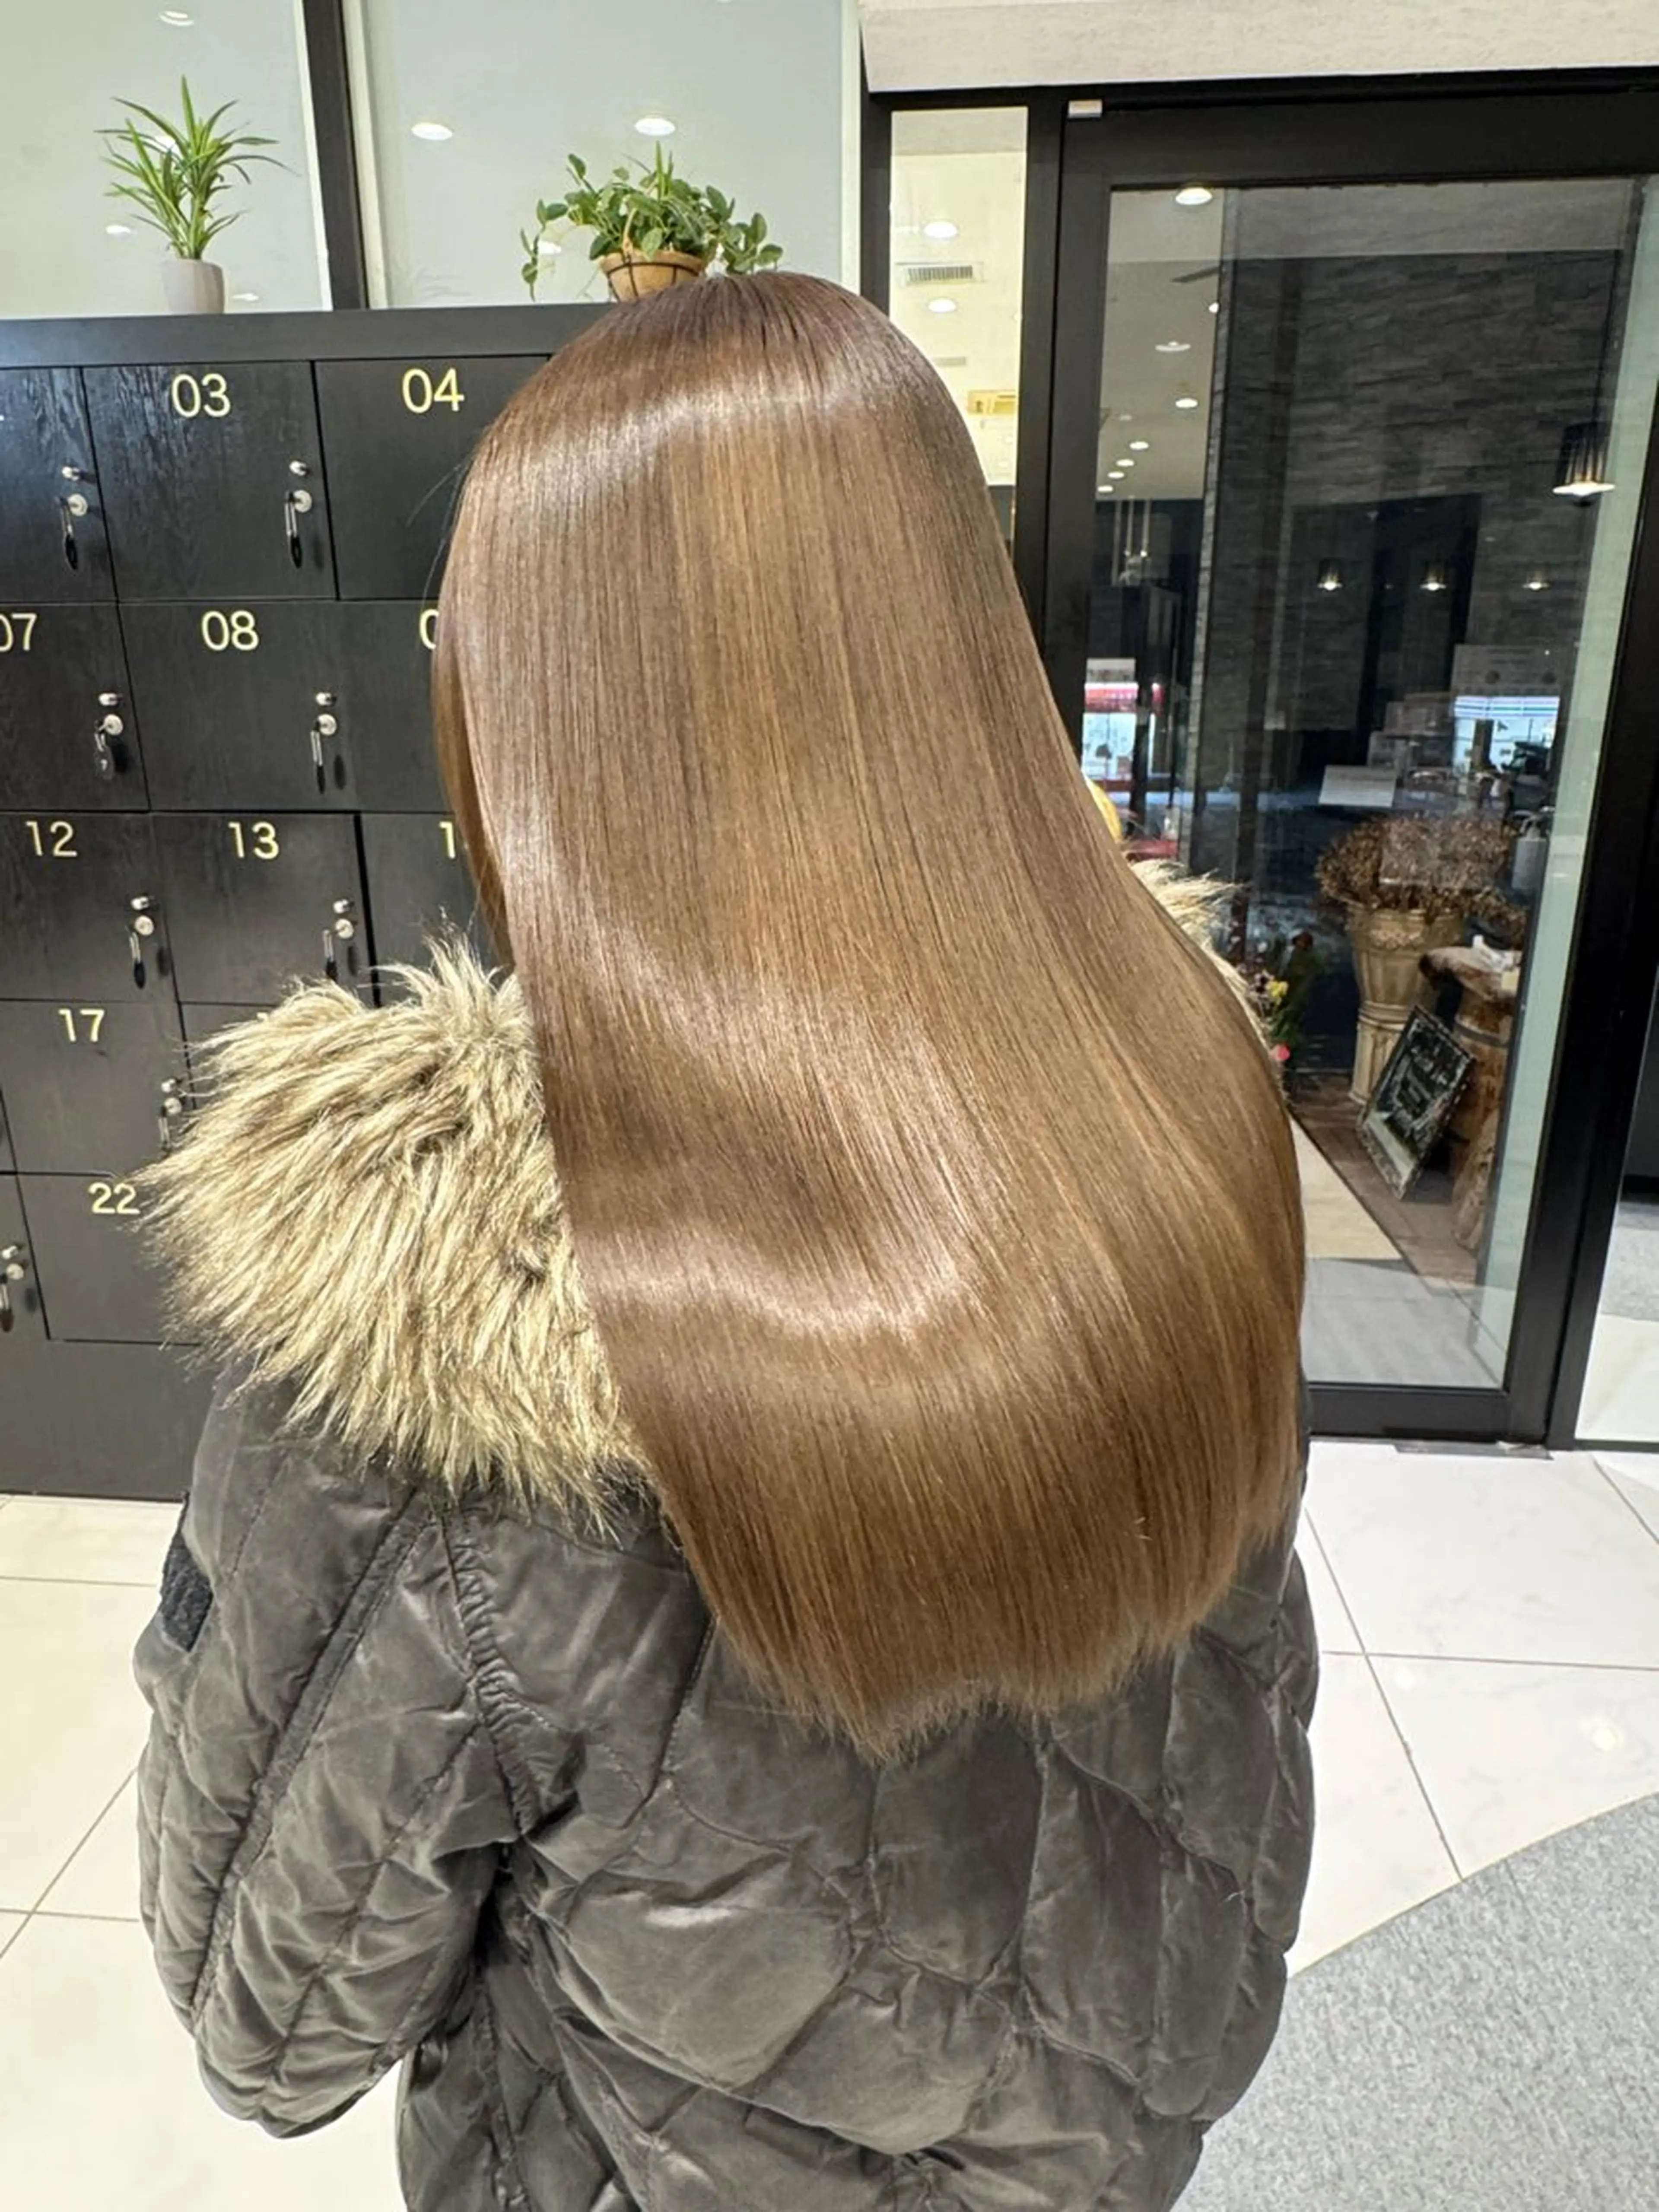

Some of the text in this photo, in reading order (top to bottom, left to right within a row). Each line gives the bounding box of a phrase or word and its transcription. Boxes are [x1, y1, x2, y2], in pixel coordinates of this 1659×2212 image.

[172, 374, 230, 417] 03
[403, 368, 464, 413] 04
[202, 611, 258, 650] 08
[27, 822, 76, 856] 12
[229, 822, 278, 859] 13
[59, 1009, 104, 1042] 17
[88, 1182, 141, 1214] 22
